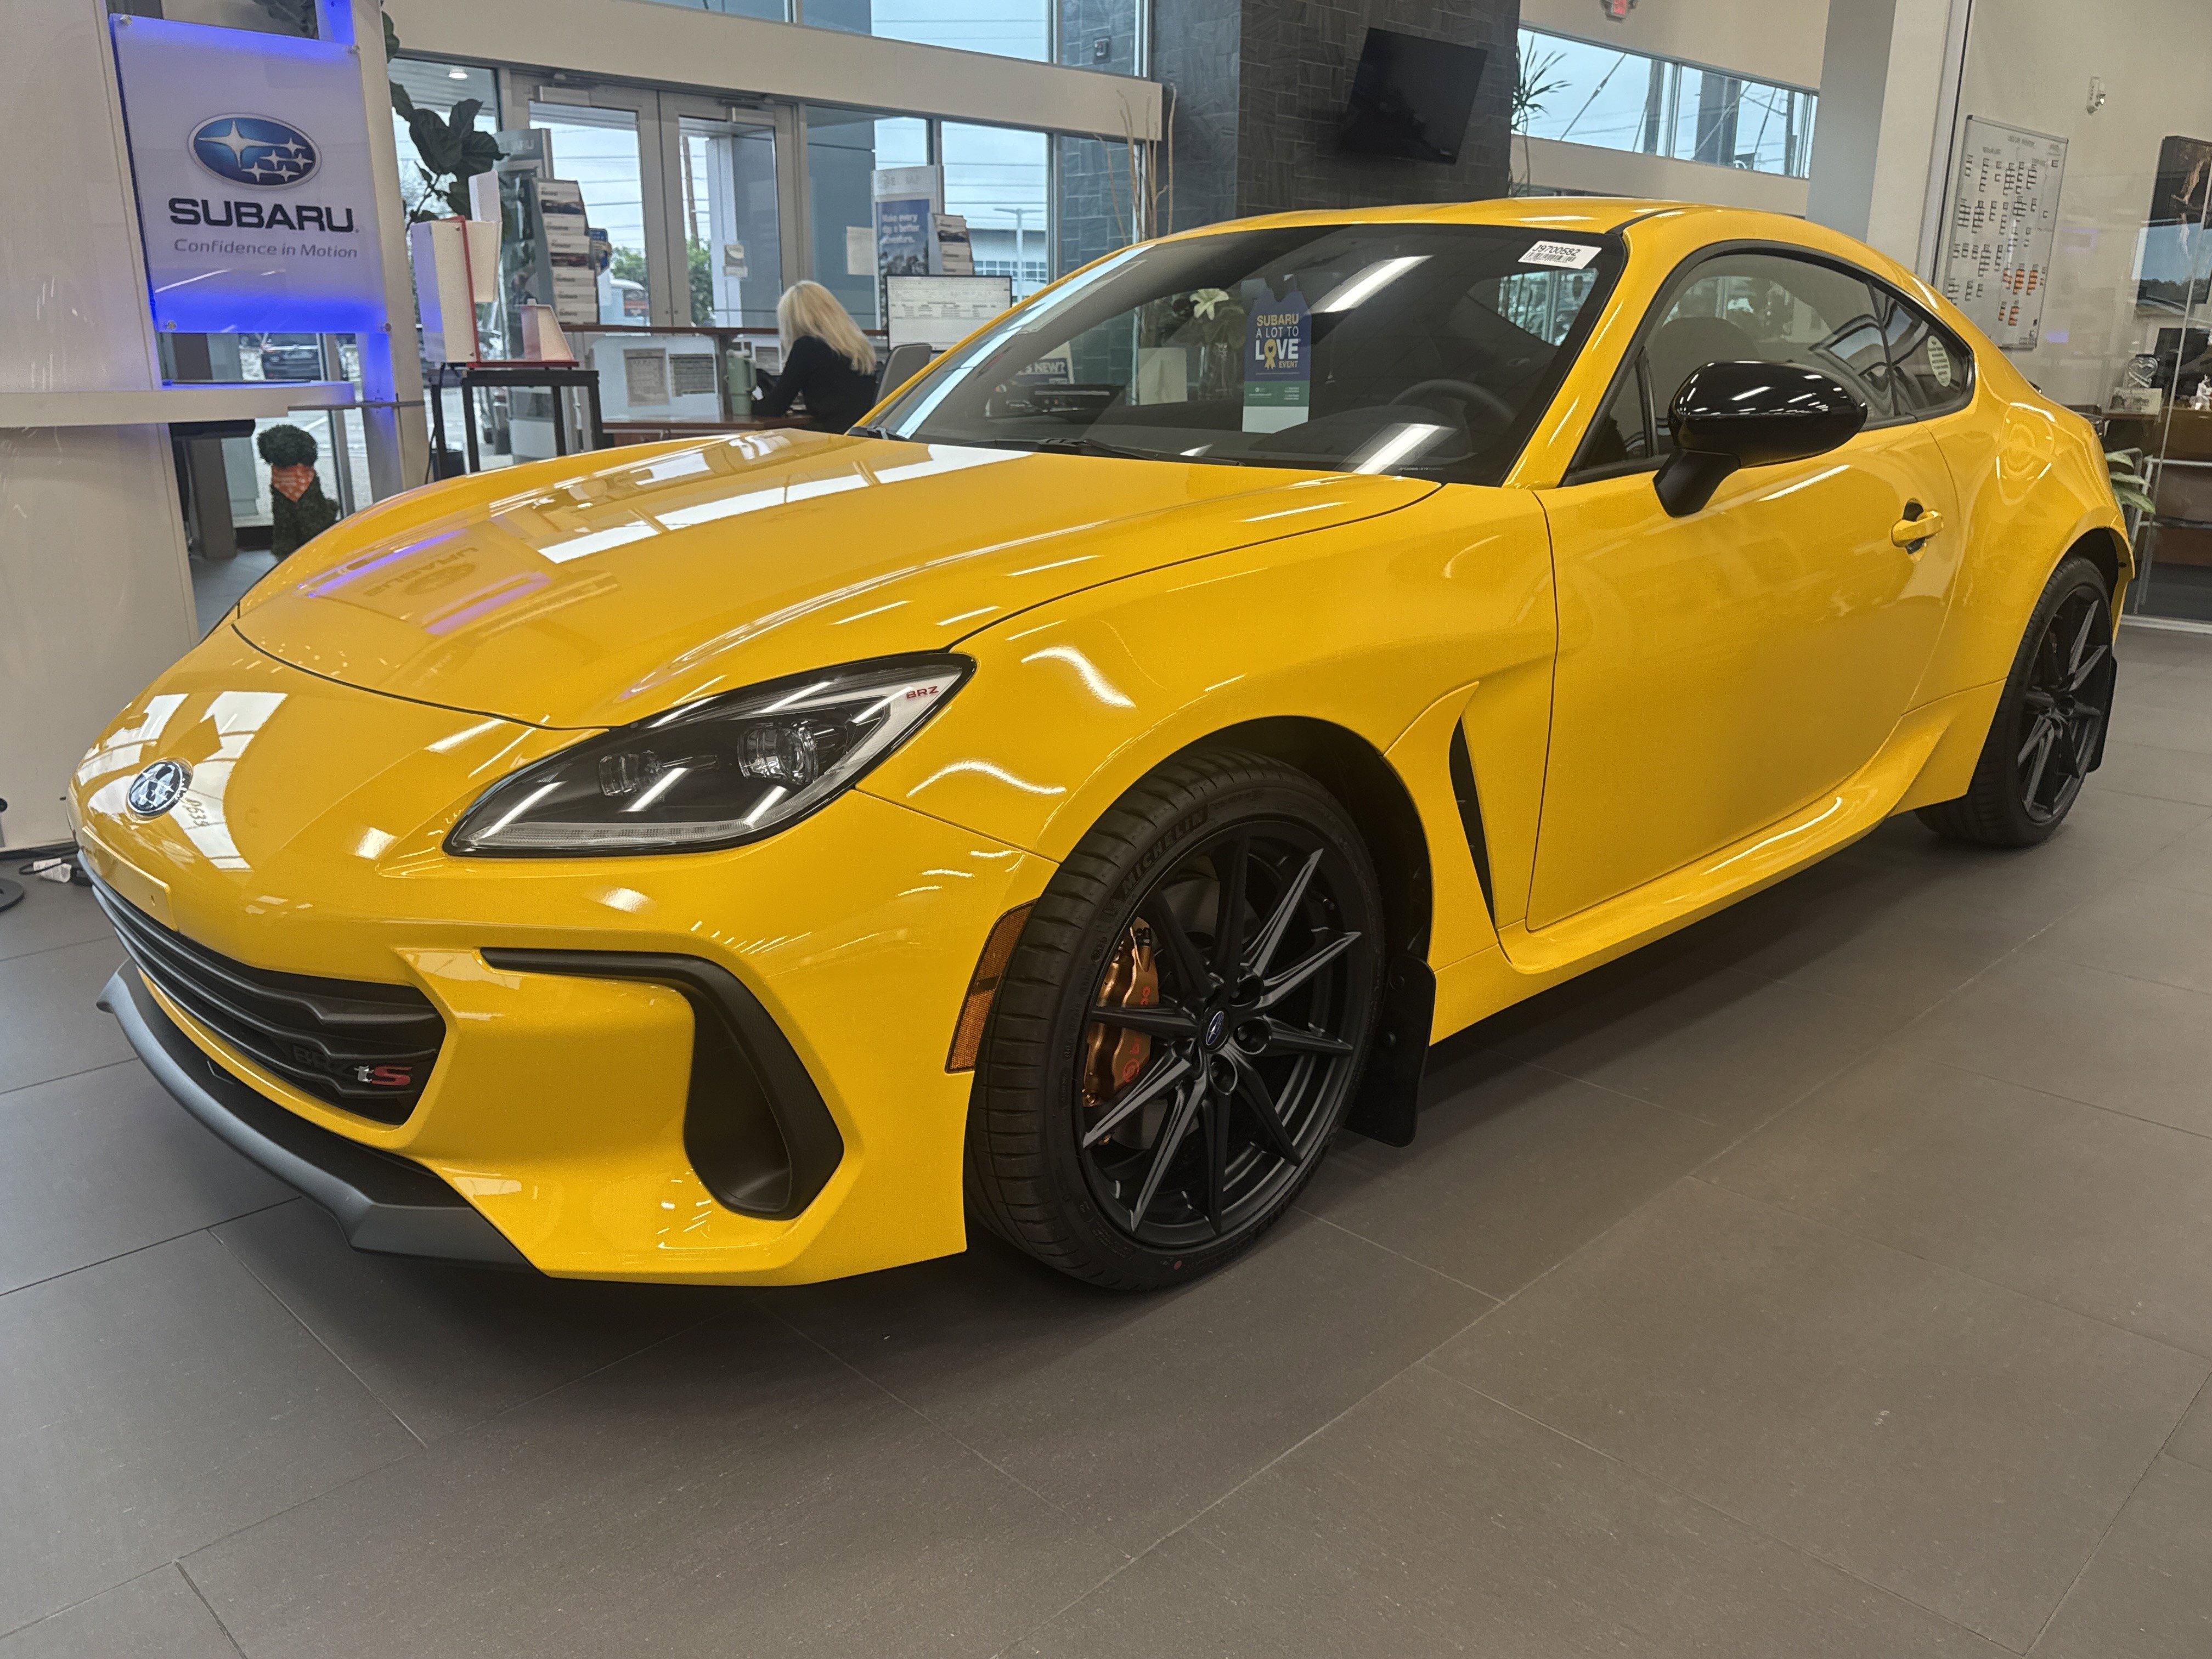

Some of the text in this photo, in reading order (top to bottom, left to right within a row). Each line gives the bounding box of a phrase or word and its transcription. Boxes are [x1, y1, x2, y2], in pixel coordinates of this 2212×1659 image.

[168, 198, 355, 233] SUBARU
[173, 238, 358, 258] Confidence in Motion
[1532, 244, 1581, 256] J9700582
[1256, 313, 1299, 326] SUBARU
[1256, 326, 1299, 338] A LOT TO
[1255, 338, 1299, 363] LOVE
[1035, 362, 1065, 374] NEW?
[906, 686, 939, 699] BRZ
[1122, 809, 1206, 893] MICHELIN
